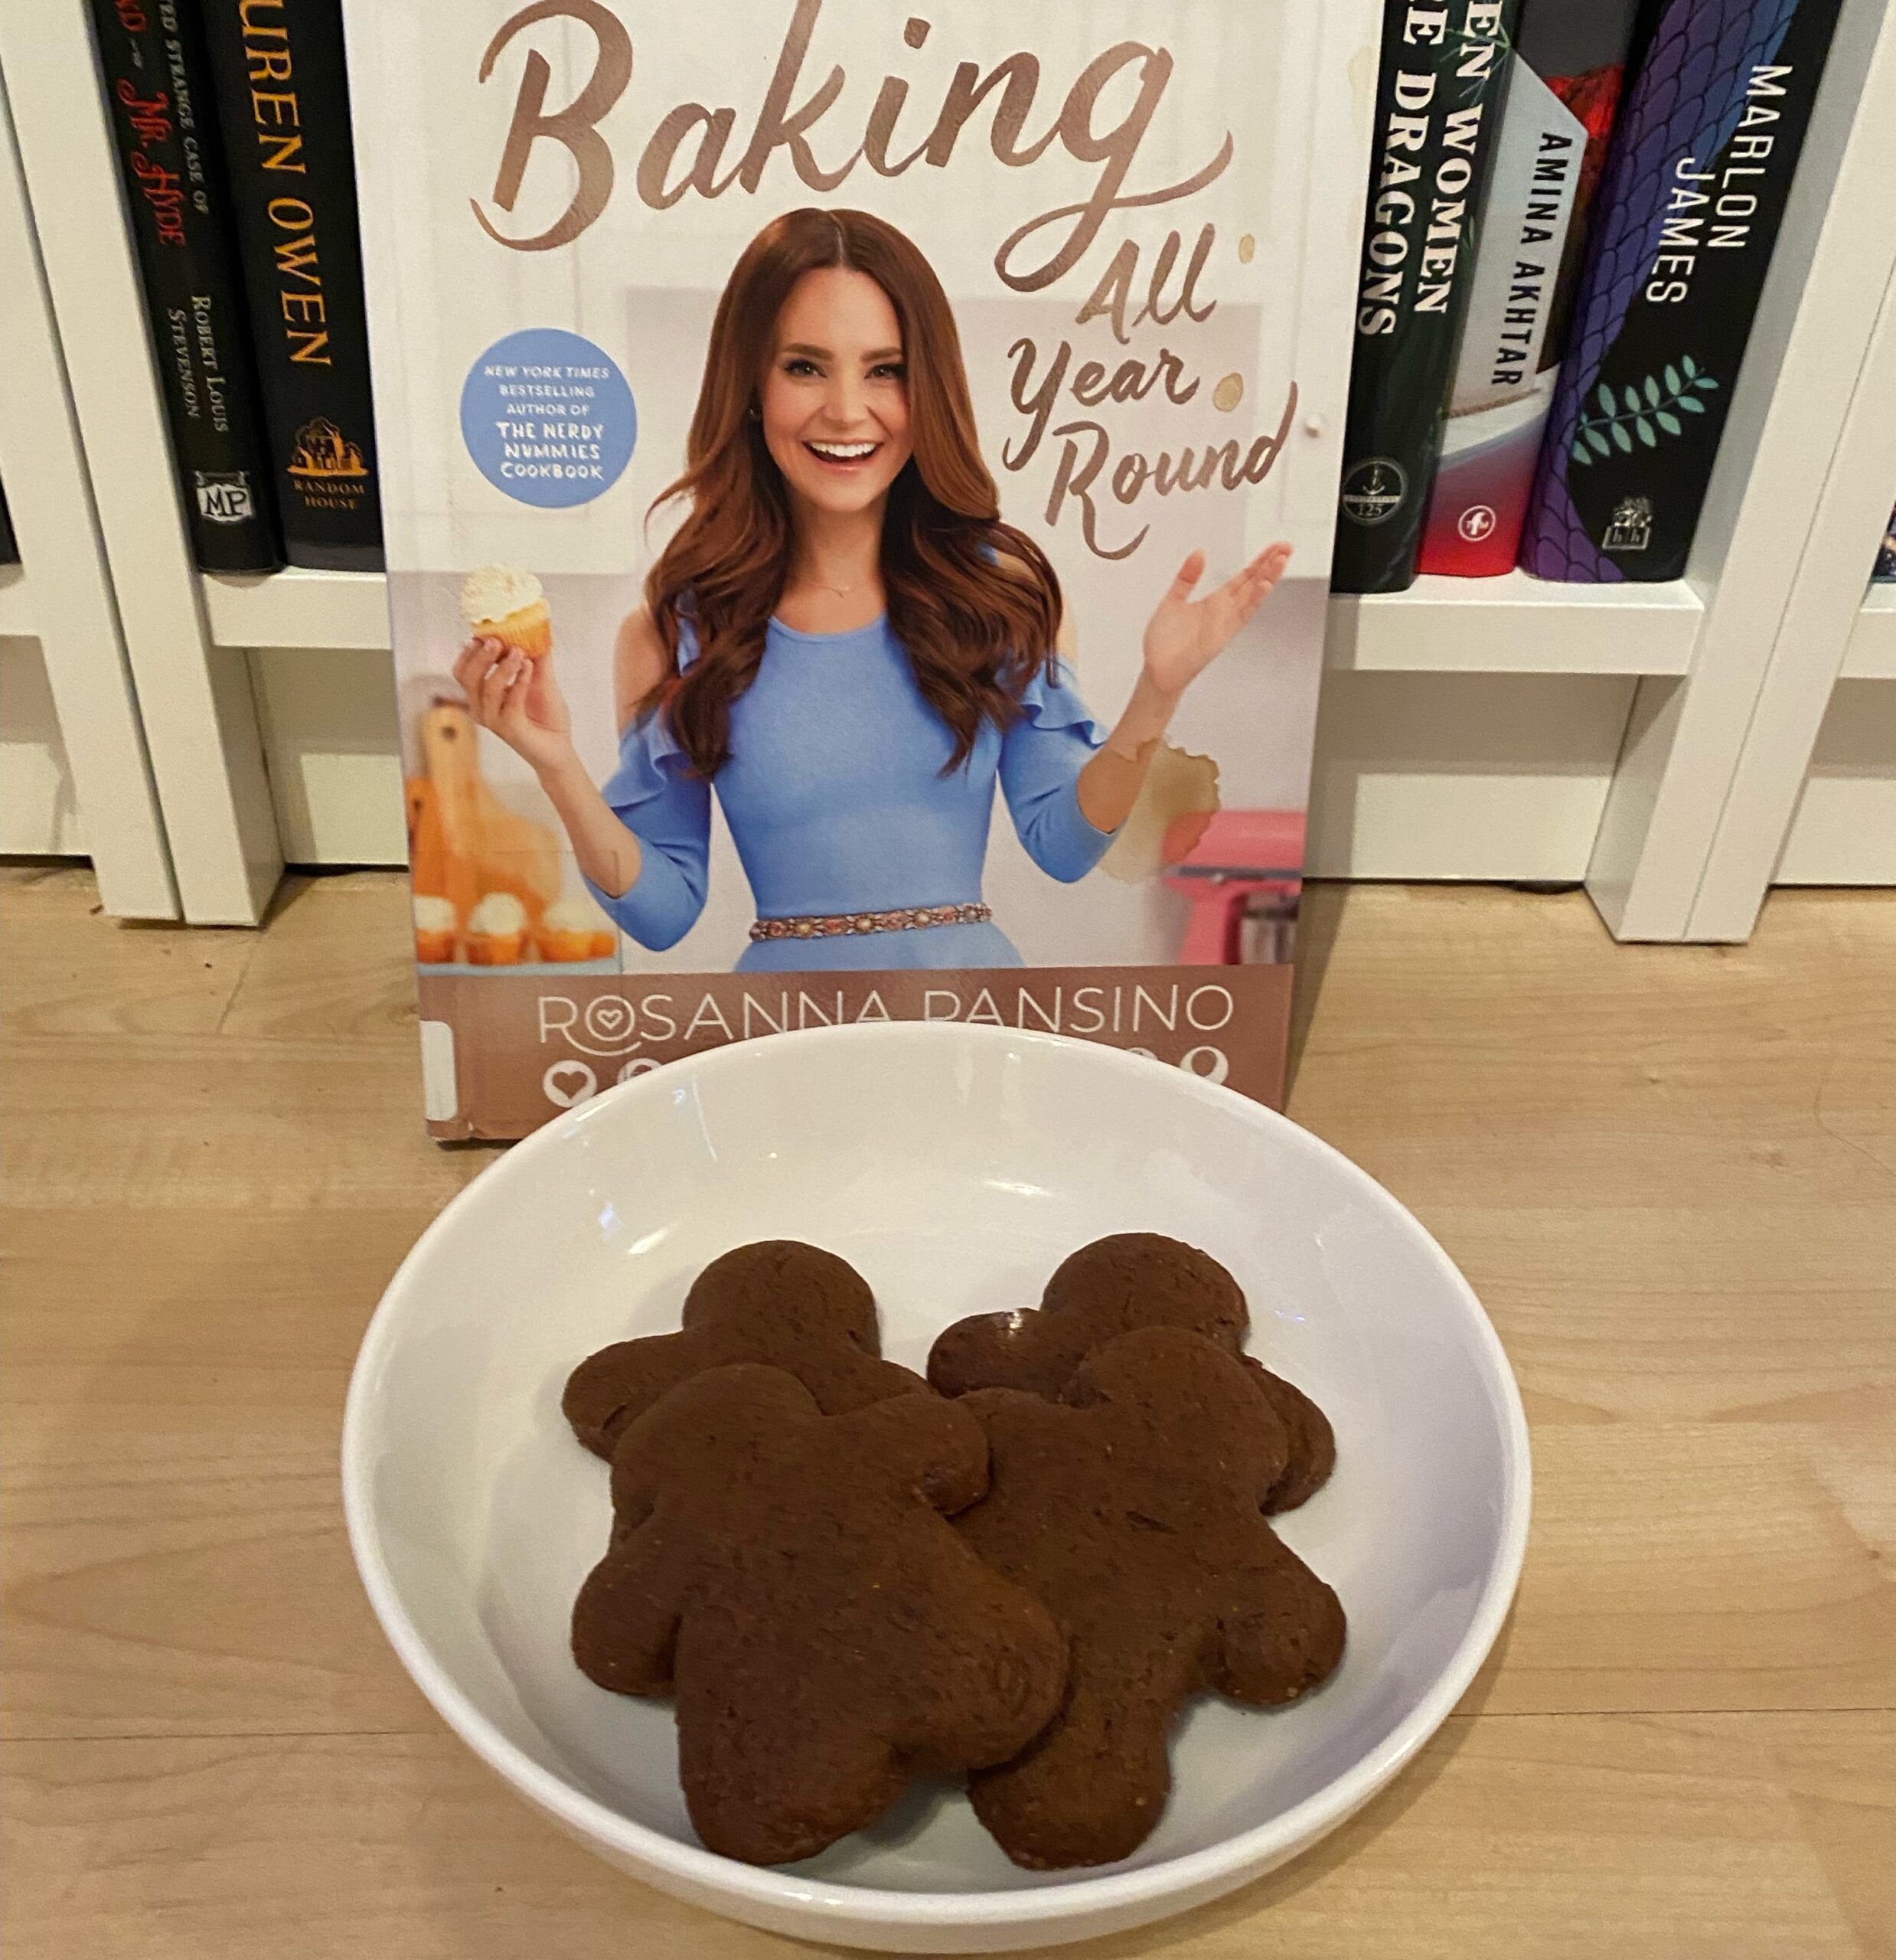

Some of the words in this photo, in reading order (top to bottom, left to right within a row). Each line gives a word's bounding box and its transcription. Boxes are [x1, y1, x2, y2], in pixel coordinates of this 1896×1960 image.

[165, 39, 194, 129] STRANGE
[184, 136, 204, 184] CASE
[470, 0, 1233, 292] Baking
[1707, 65, 1793, 248] MARLON
[193, 190, 210, 215] OF
[1358, 69, 1438, 335] DRAGONS
[1414, 103, 1483, 314] WOMEN
[1520, 132, 1572, 244] AMINA
[1646, 157, 1716, 303] JAMES
[268, 197, 331, 365] OWEN
[1075, 223, 1217, 345] All
[1492, 260, 1545, 384] AKHTAR
[485, 364, 517, 377] NEW
[523, 365, 563, 379] YORK
[566, 366, 610, 380] TIMES
[499, 384, 596, 398] BESTSELLING
[506, 403, 567, 416] AUTHOR
[570, 403, 590, 416] OF
[1003, 338, 1200, 472] Year
[496, 420, 536, 439] THE
[543, 422, 604, 440] NERDY
[500, 461, 604, 480] COOKBOOK
[504, 442, 601, 460] NUMMIES
[1044, 381, 1298, 560] Round
[204, 486, 246, 518] MP
[293, 479, 365, 495] RANDOM
[304, 495, 356, 510] HOUSE
[538, 989, 891, 1057] ROSANNA
[924, 985, 1234, 1033] PANSINO
